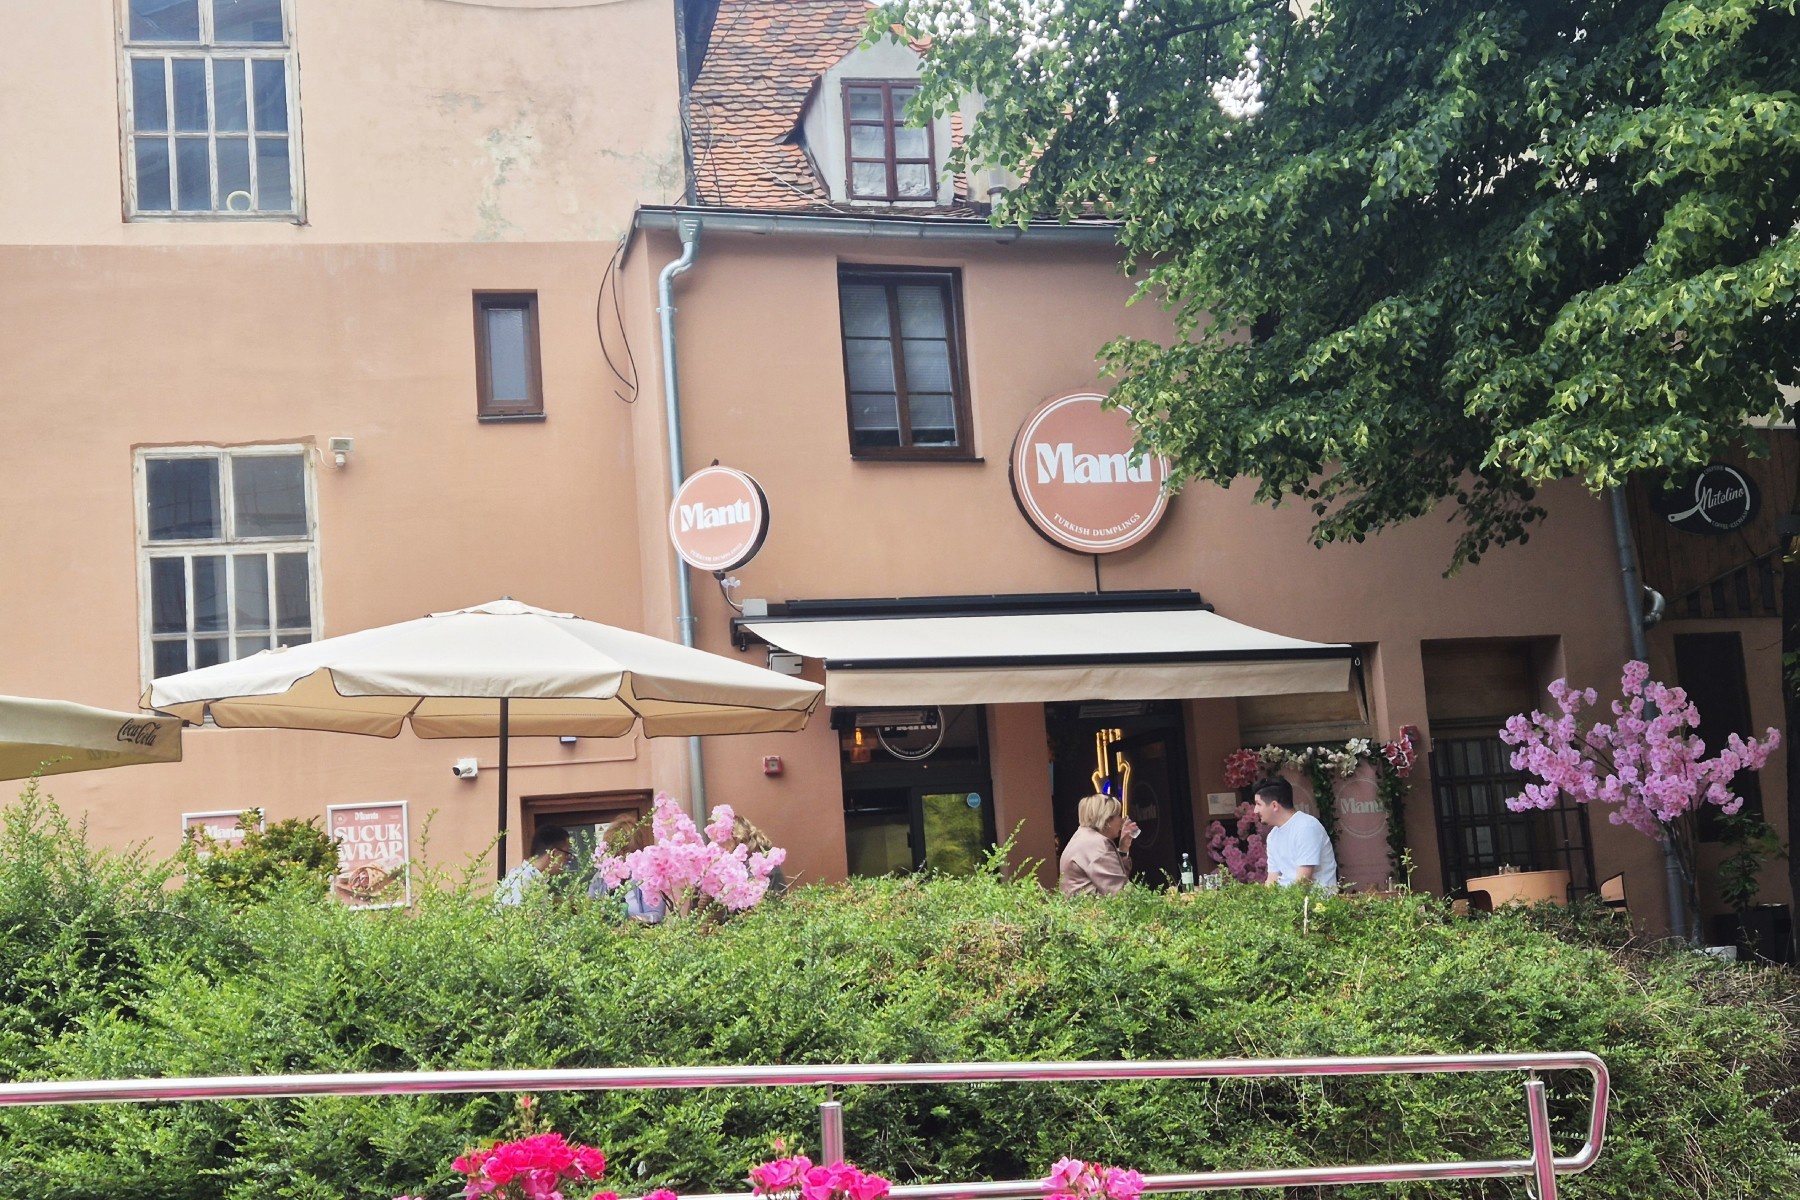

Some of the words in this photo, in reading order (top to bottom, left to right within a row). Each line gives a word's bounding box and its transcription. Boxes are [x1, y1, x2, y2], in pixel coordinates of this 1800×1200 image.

[1053, 513, 1090, 536] TURKISH
[1092, 512, 1141, 537] DUMPLINGS
[1340, 798, 1384, 814] Mant
[334, 823, 402, 844] SUCUK
[337, 840, 403, 861] WRAP
